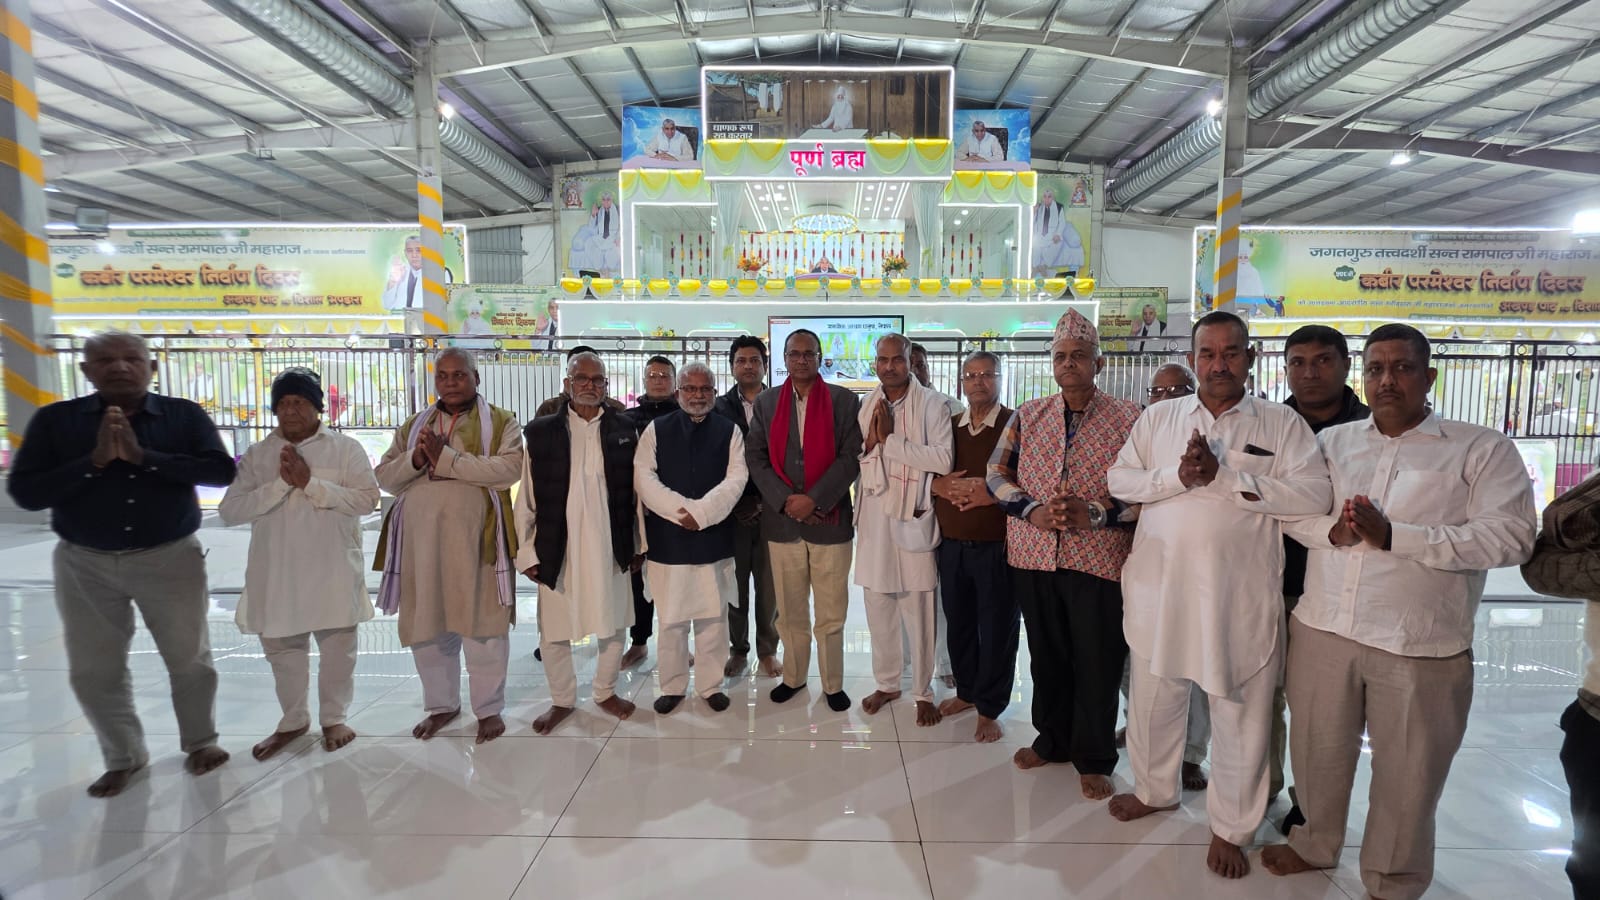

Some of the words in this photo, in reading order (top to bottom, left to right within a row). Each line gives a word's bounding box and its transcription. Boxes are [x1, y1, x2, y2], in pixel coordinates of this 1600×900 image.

[789, 142, 824, 177] पूर्ण
[831, 150, 867, 171] ब्रह्म
[178, 244, 228, 255] रामपाल
[230, 241, 248, 255] जी
[250, 244, 301, 256] महाराज
[1309, 247, 1373, 262] जगतगुरु
[1429, 248, 1458, 259] सन्त
[1461, 249, 1513, 260] रामपाल
[1516, 246, 1535, 260] जी
[1537, 249, 1592, 261] महाराज
[129, 264, 197, 286] परमेश्वर
[200, 263, 251, 286] निर्वाण
[255, 264, 300, 287] दिवस
[1359, 267, 1404, 290] कबीर
[1406, 269, 1477, 292] परमेश्वर
[1480, 269, 1534, 292] निर्वाण
[1538, 269, 1586, 293] दिवस
[1573, 300, 1600, 312] विशा
